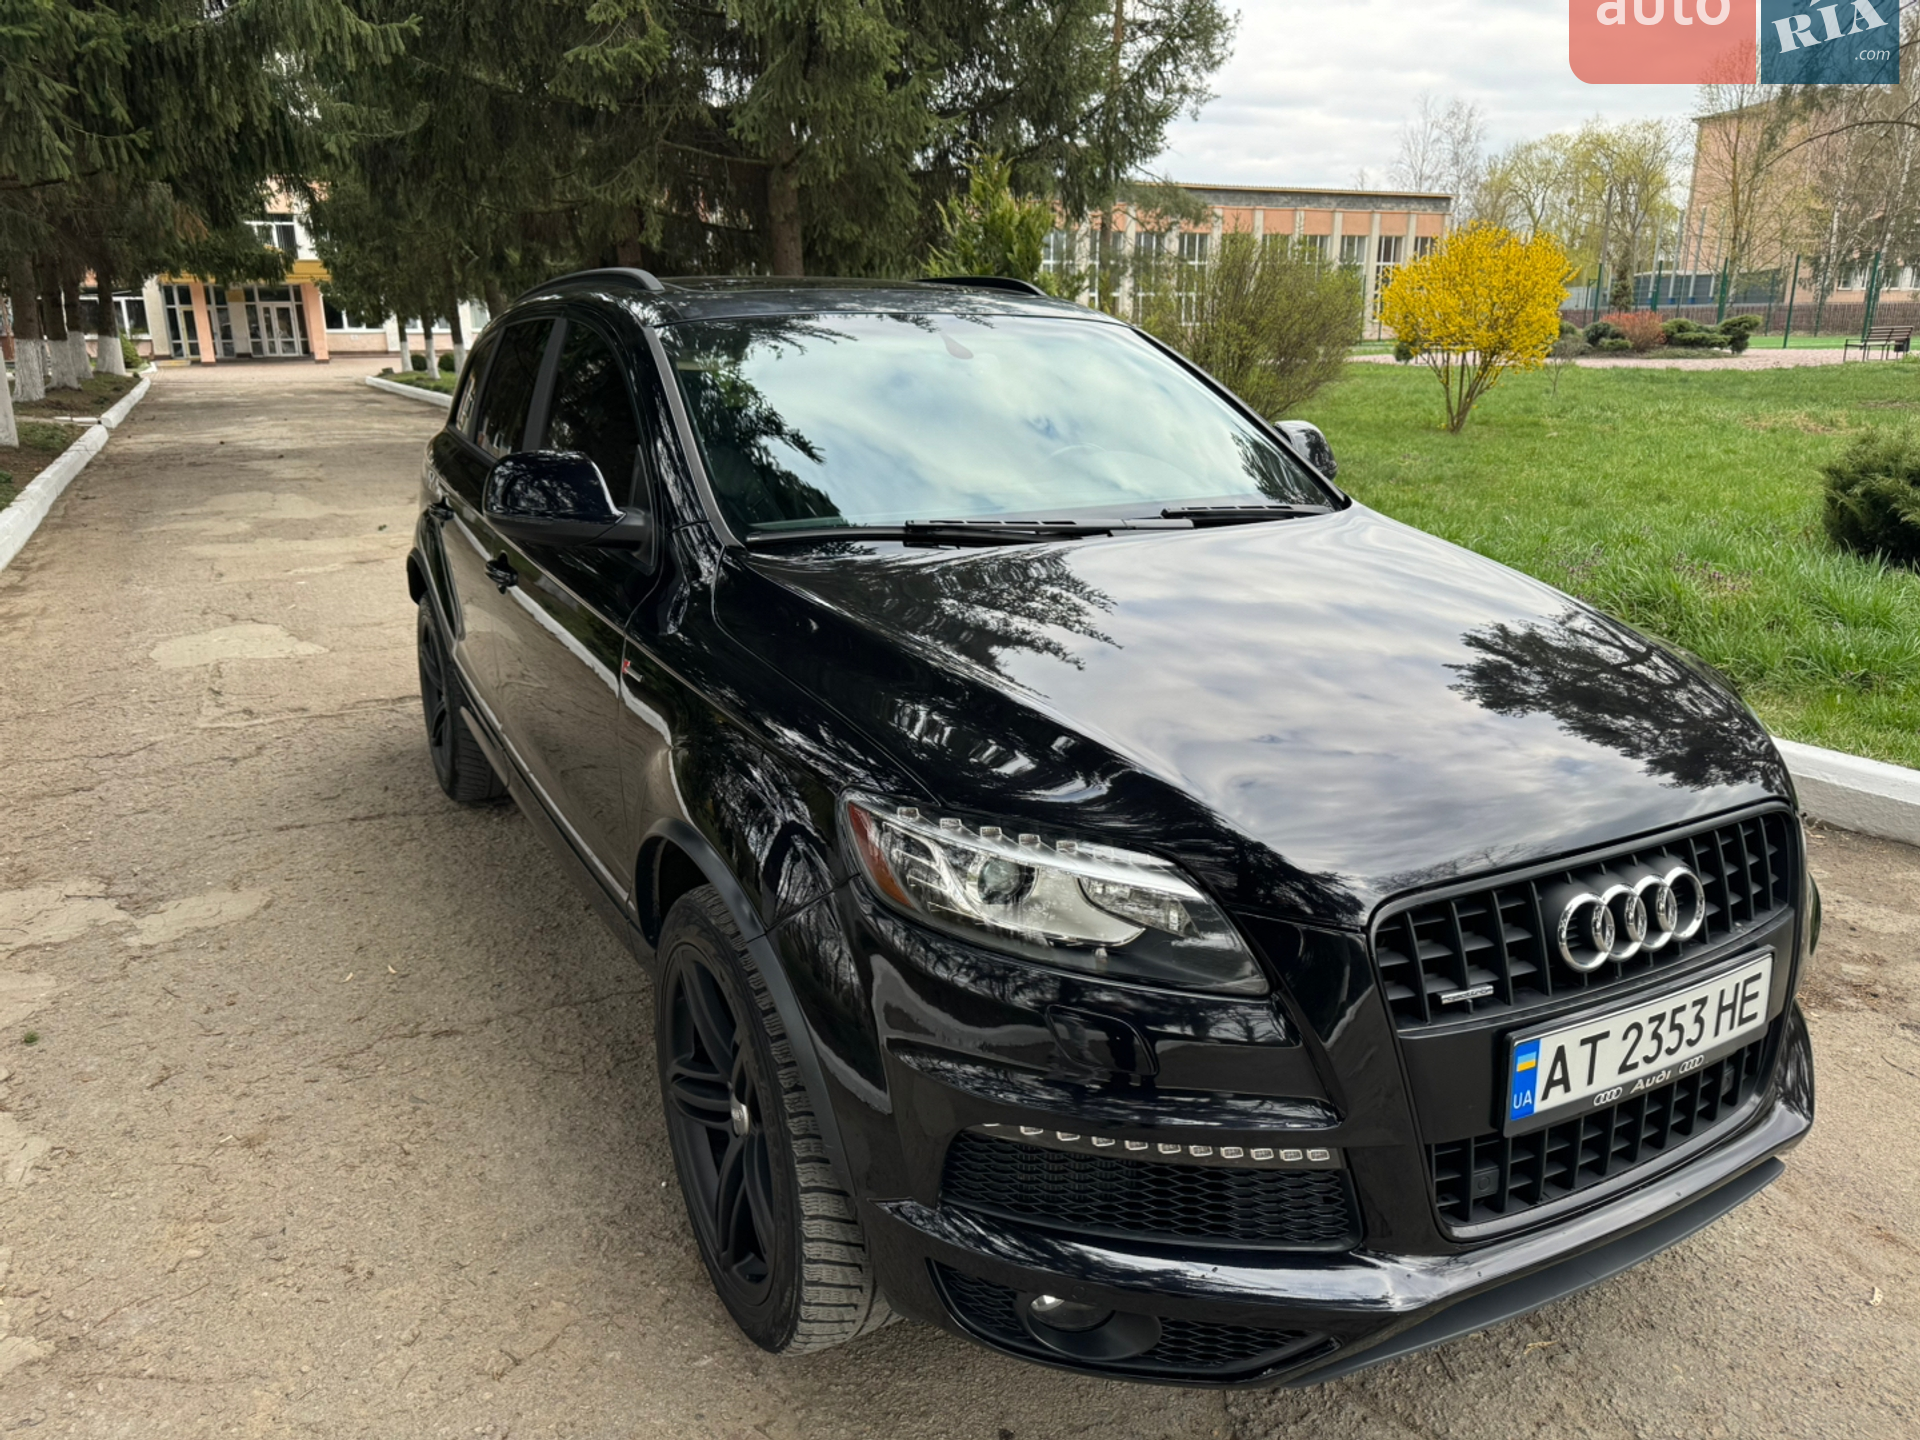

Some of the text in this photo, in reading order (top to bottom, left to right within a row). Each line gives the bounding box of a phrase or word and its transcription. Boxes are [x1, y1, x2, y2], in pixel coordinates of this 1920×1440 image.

[1541, 972, 1762, 1101] AT 2353 HE
[1630, 1069, 1672, 1095] Audi
[1513, 1089, 1533, 1110] UA
